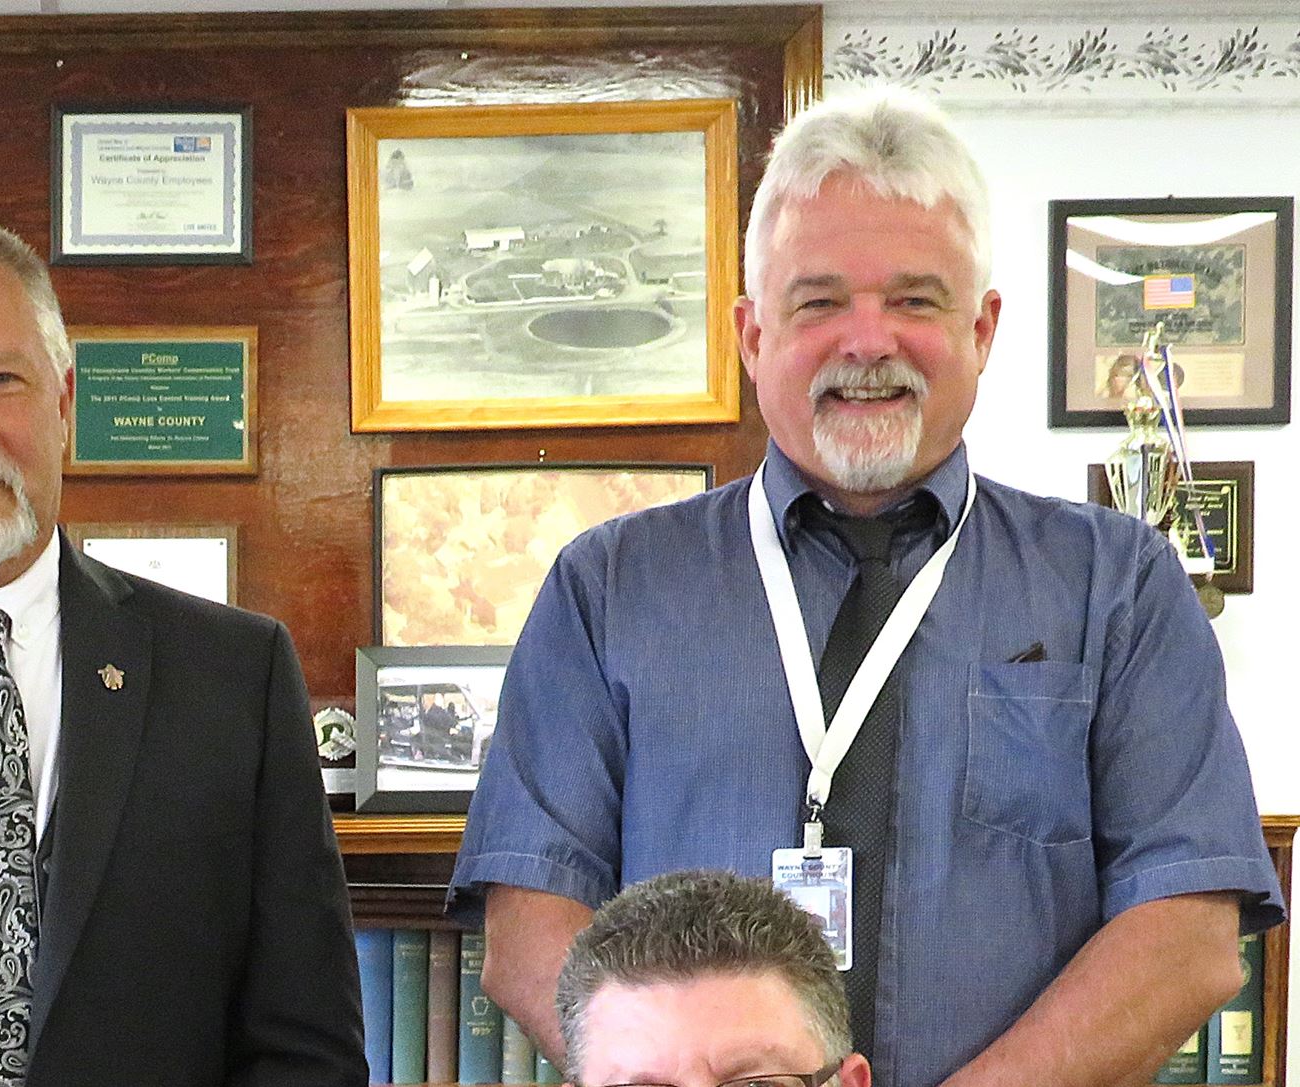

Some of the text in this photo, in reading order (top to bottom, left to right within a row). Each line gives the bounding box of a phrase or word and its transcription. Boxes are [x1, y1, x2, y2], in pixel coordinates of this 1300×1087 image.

[98, 153, 206, 164] Certificate of Appreciation
[91, 175, 213, 187] Wayne County Employees
[141, 353, 179, 365] PComp
[113, 415, 206, 427] WAYNE COUNTY
